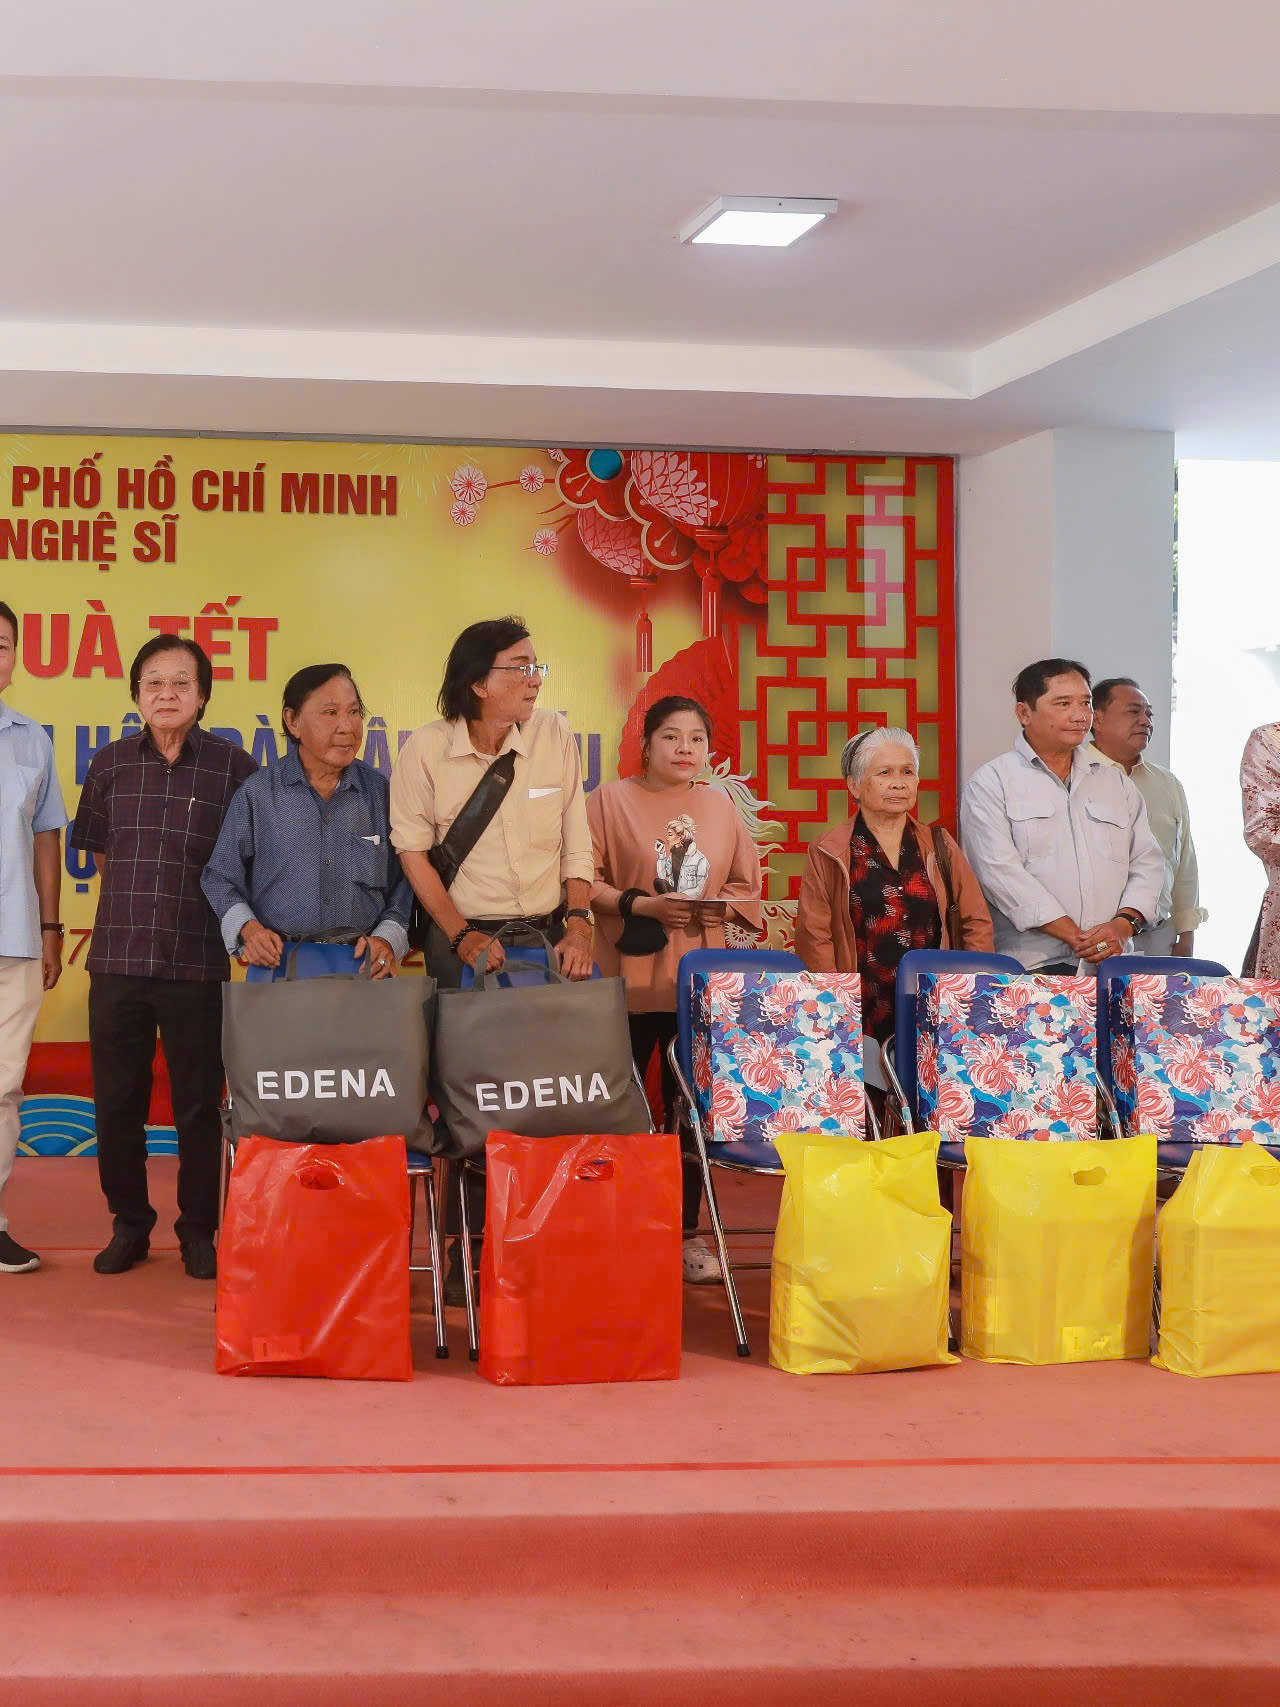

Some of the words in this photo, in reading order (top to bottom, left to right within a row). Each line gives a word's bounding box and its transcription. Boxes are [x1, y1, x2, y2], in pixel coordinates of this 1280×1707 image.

[12, 452, 103, 509] PHỐ
[117, 455, 177, 510] HỒ
[192, 462, 266, 513] CHÍ
[280, 471, 398, 516] MINH
[132, 513, 180, 564] SĨ
[23, 599, 125, 679] UÀ
[256, 1068, 396, 1099] EDENA
[475, 1072, 611, 1112] EDENA
